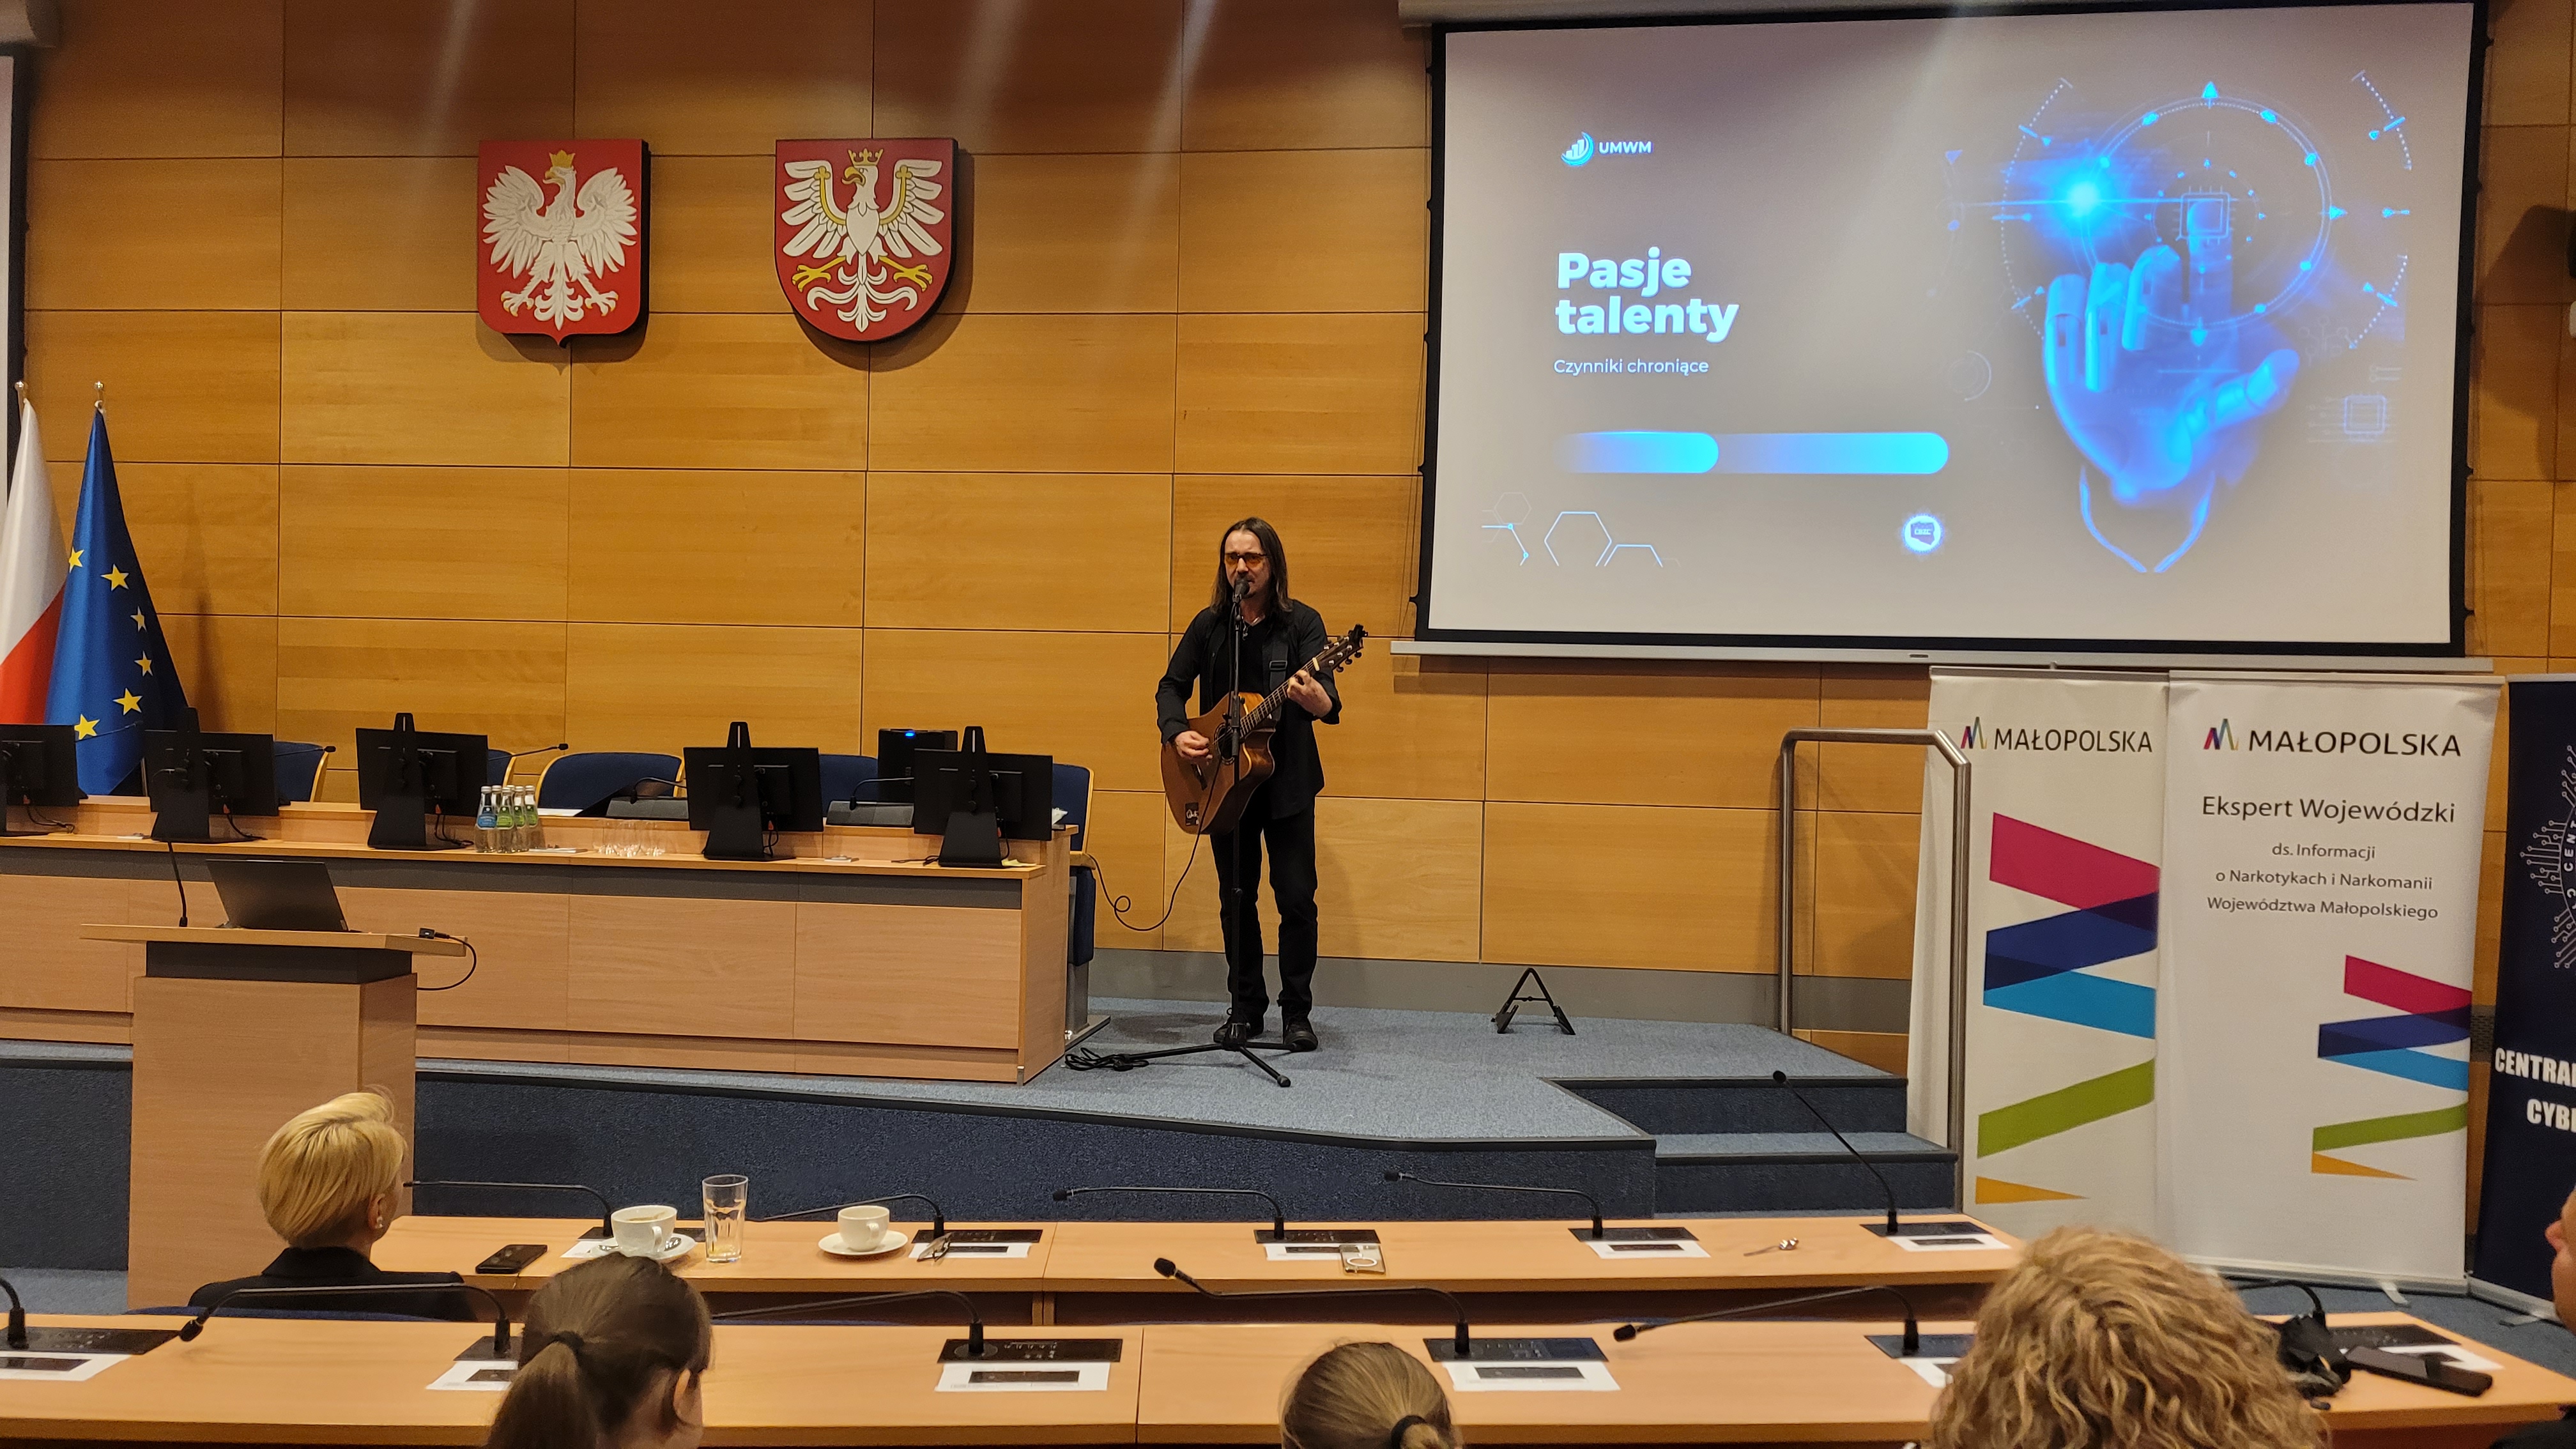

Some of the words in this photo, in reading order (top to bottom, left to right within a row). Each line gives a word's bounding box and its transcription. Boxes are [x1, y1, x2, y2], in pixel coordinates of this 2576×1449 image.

[1598, 141, 1652, 155] UMWM
[1558, 246, 1692, 298] Pasje
[1554, 295, 1740, 343] talenty
[1554, 358, 1623, 376] Czynniki
[1627, 358, 1709, 376] chroniące
[1994, 728, 2152, 753] MAŁOPOLSKA
[2249, 730, 2461, 757] MAŁOPOLSKA
[2203, 795, 2294, 821] Ekspert
[2299, 799, 2455, 824] Wojewódzki
[2272, 842, 2294, 855] ds.
[2297, 843, 2375, 862] Informacji
[2216, 872, 2226, 882] o
[2230, 870, 2327, 887] Narkotykach
[2331, 873, 2335, 885] i
[2340, 873, 2432, 890] Narkomanii
[2207, 897, 2315, 913] Województwa
[2320, 901, 2438, 921] Małopolskiego
